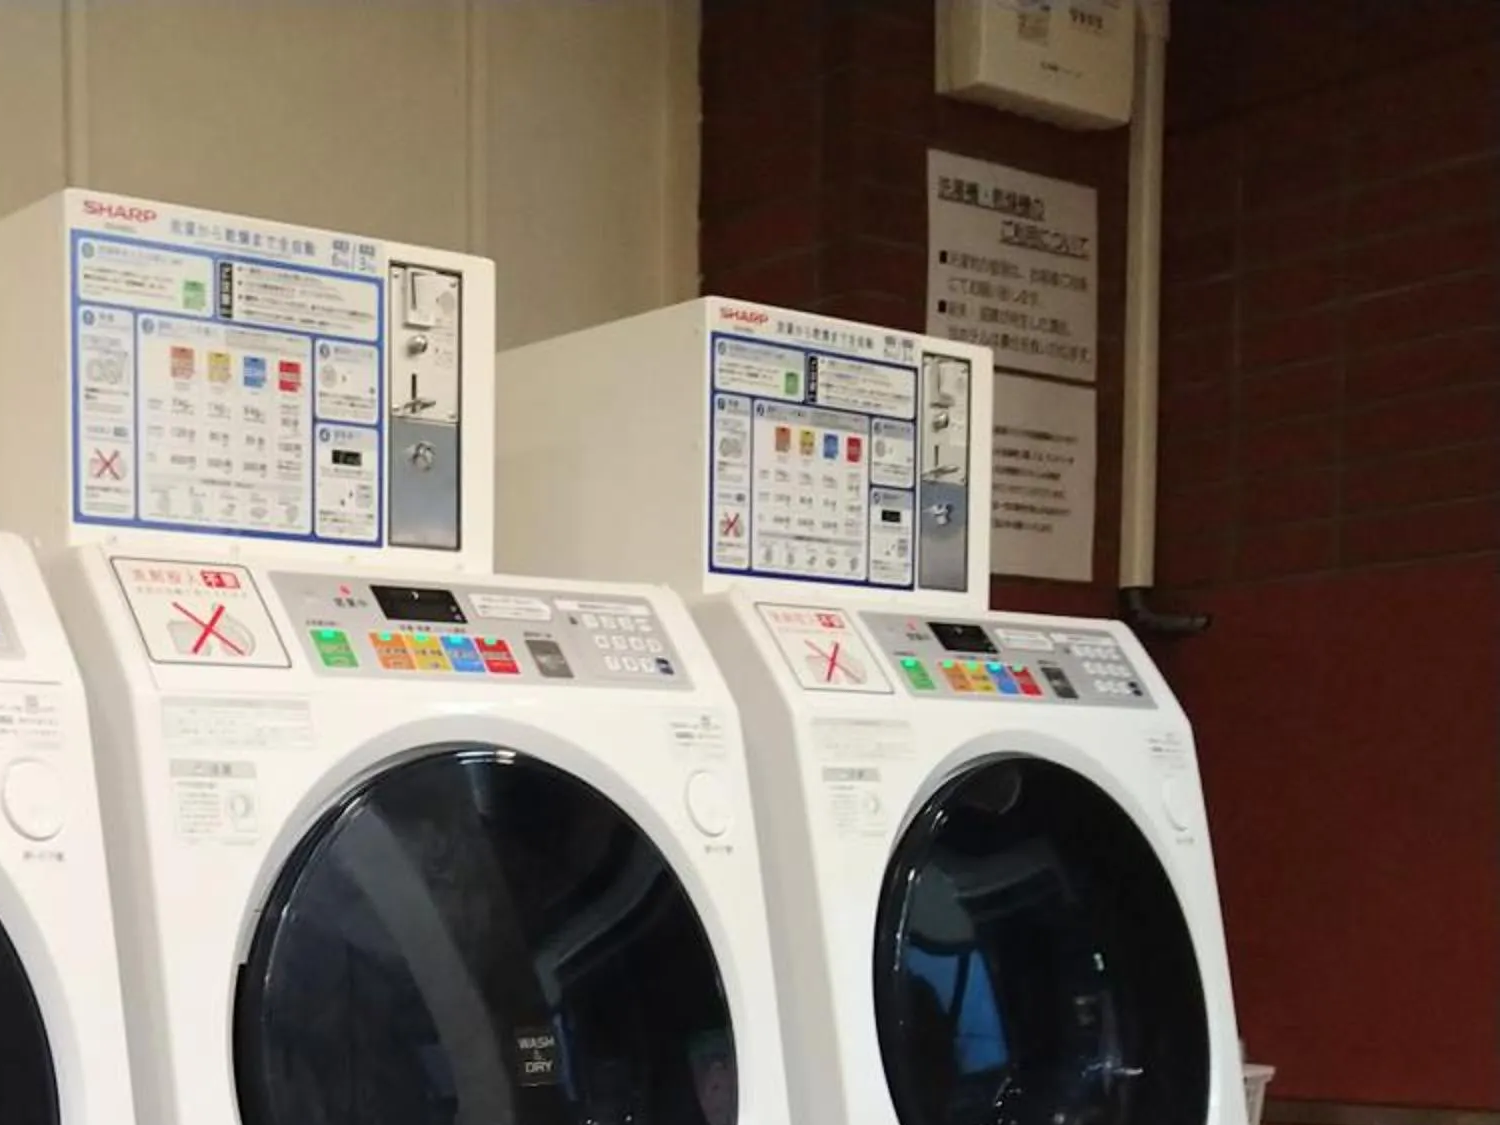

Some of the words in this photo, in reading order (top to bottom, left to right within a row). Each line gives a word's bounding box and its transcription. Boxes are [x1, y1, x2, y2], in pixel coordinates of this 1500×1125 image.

[83, 200, 157, 222] SHARP
[720, 307, 769, 324] SHARP
[518, 1036, 555, 1049] WASH
[525, 1060, 553, 1073] DRY
